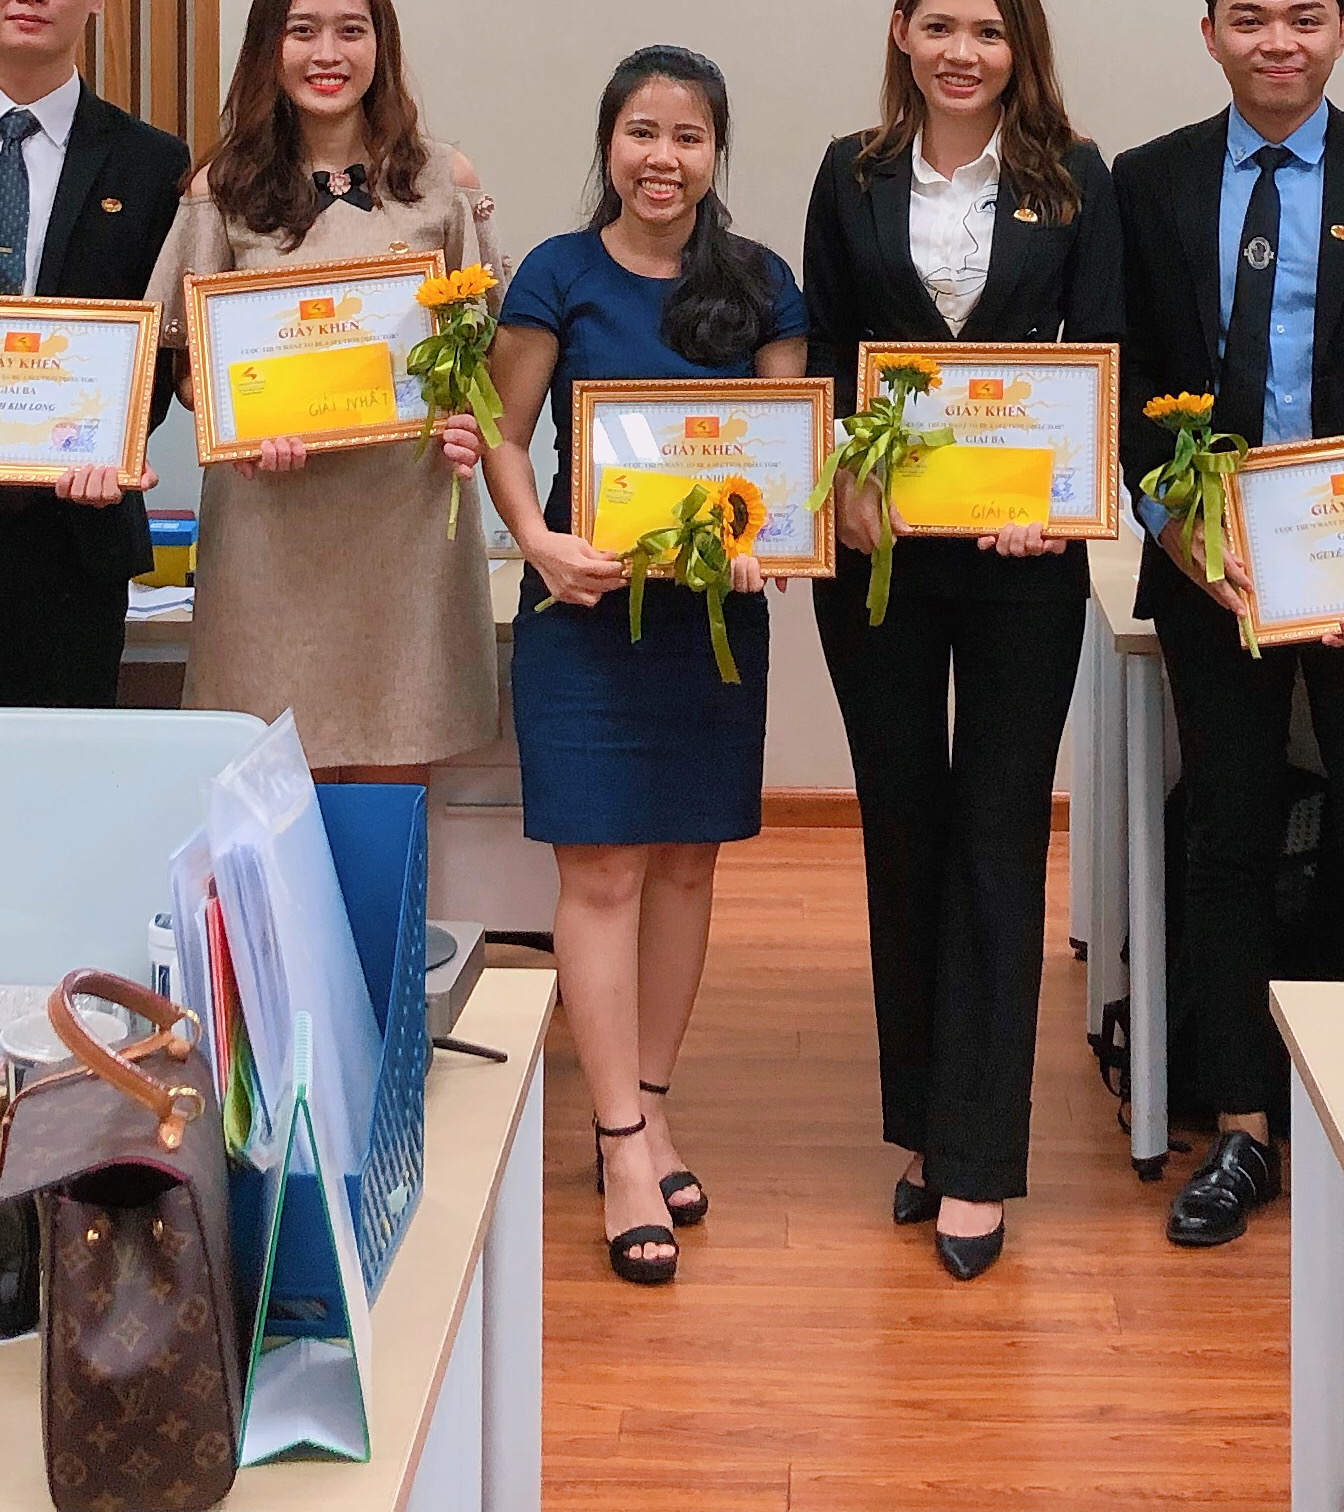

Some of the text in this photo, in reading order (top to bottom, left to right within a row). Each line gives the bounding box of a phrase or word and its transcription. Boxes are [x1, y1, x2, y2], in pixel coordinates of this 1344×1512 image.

[319, 321, 361, 335] KHEN
[19, 357, 61, 370] KHEN
[346, 386, 388, 411] NHẤT
[8, 402, 28, 411] KIM
[29, 402, 56, 412] LONG
[985, 405, 1027, 418] KHEN
[991, 435, 1005, 444] BA
[702, 444, 744, 457] KHEN
[1008, 506, 1031, 521] BA
